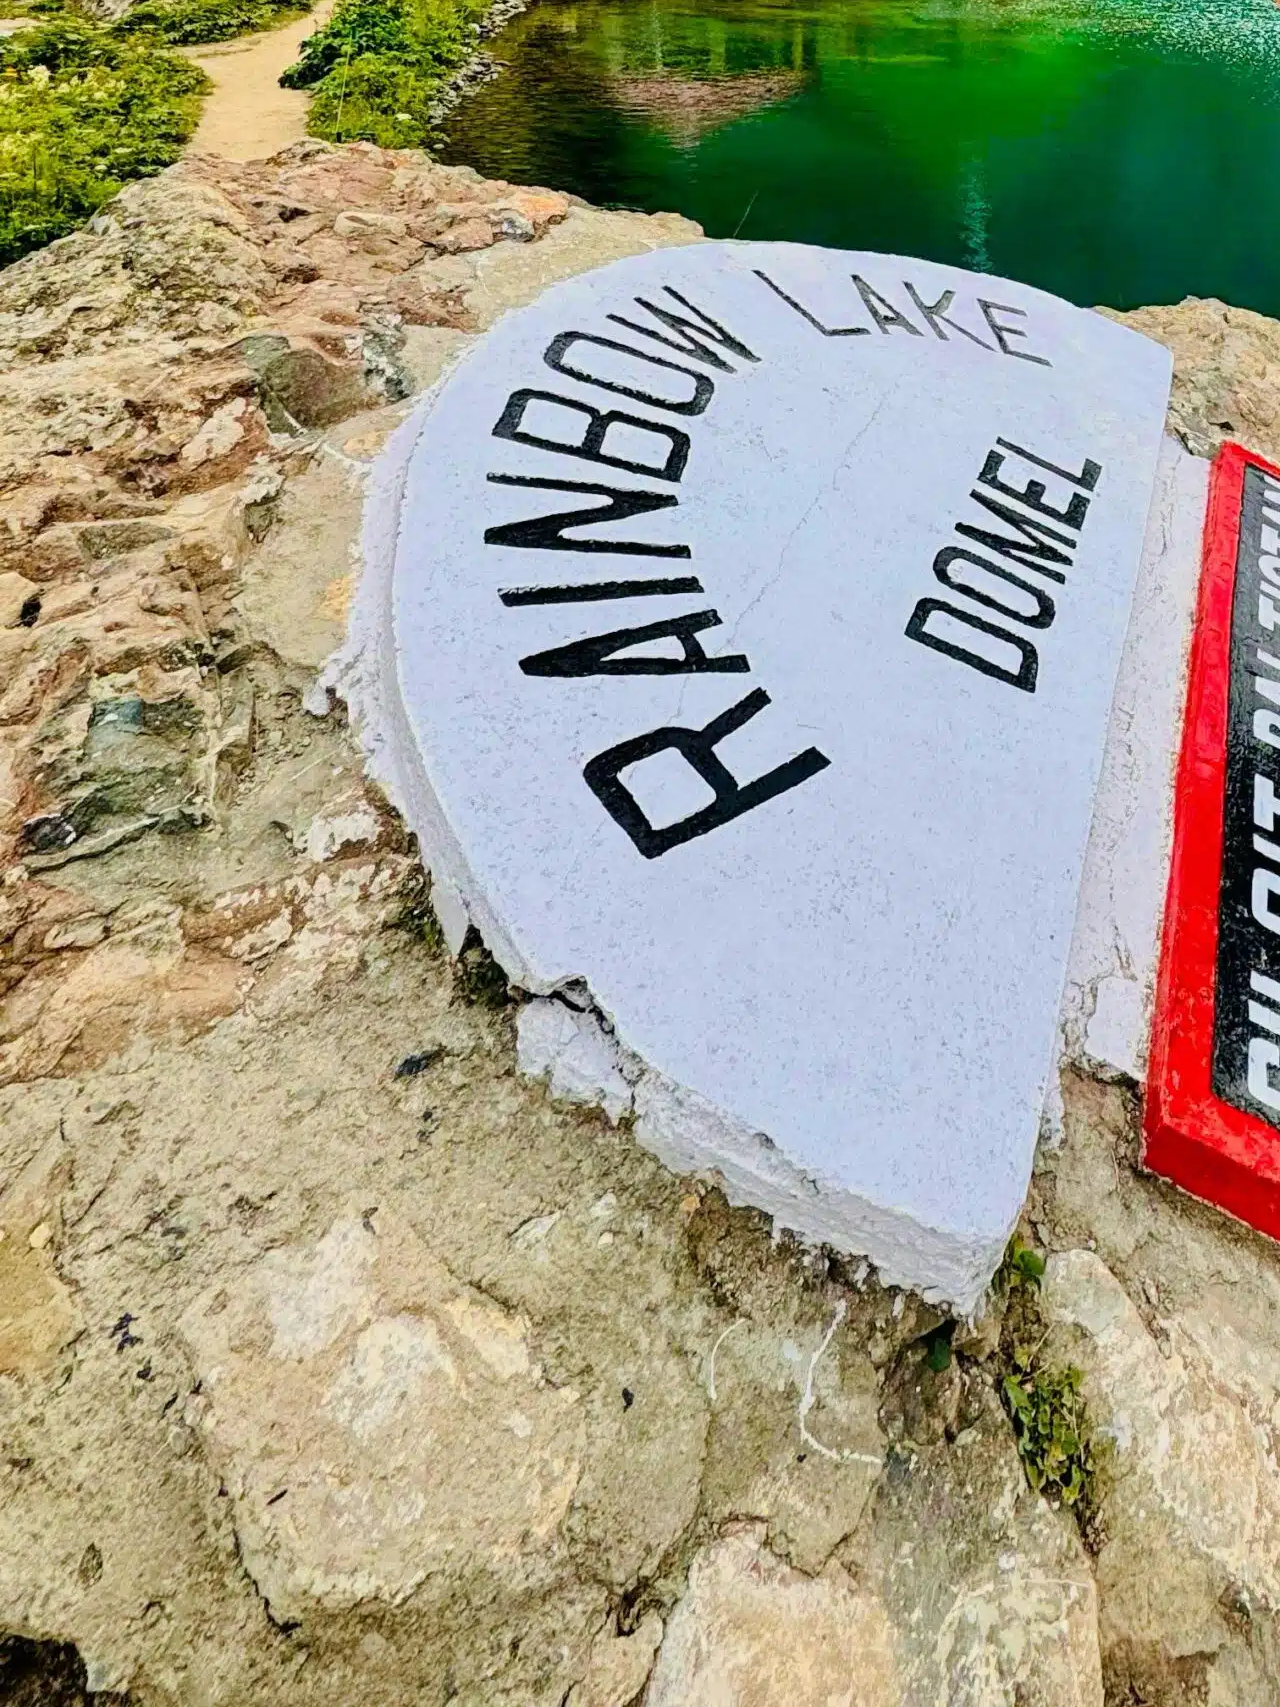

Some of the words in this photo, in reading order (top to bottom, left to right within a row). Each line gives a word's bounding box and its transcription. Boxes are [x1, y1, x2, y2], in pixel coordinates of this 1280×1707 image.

[484, 285, 832, 860] RAINBOW
[752, 270, 1053, 367] LAKE
[904, 436, 1103, 694] DOMEL
